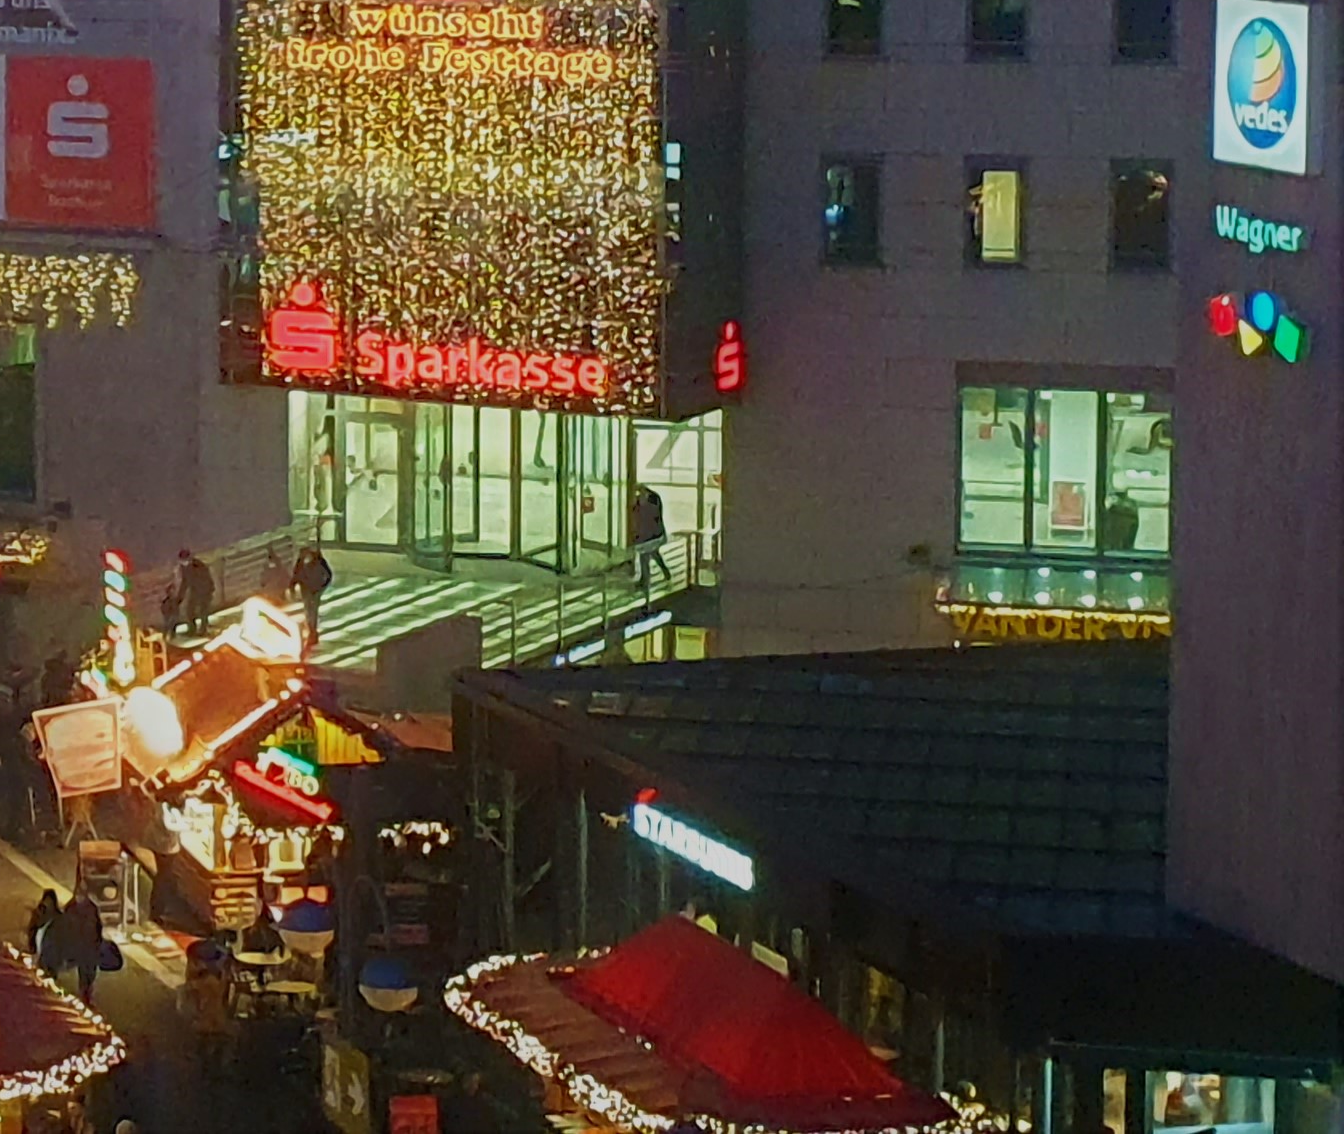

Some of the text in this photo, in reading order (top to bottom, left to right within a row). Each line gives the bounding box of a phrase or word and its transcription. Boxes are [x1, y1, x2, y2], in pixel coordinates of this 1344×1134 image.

[350, 5, 545, 40] wünscht
[287, 38, 613, 83] frohe Festtage
[1234, 101, 1288, 134] vedes
[1216, 204, 1303, 254] Wagner
[356, 333, 610, 396] Sparkasse
[1035, 613, 1106, 640] DER
